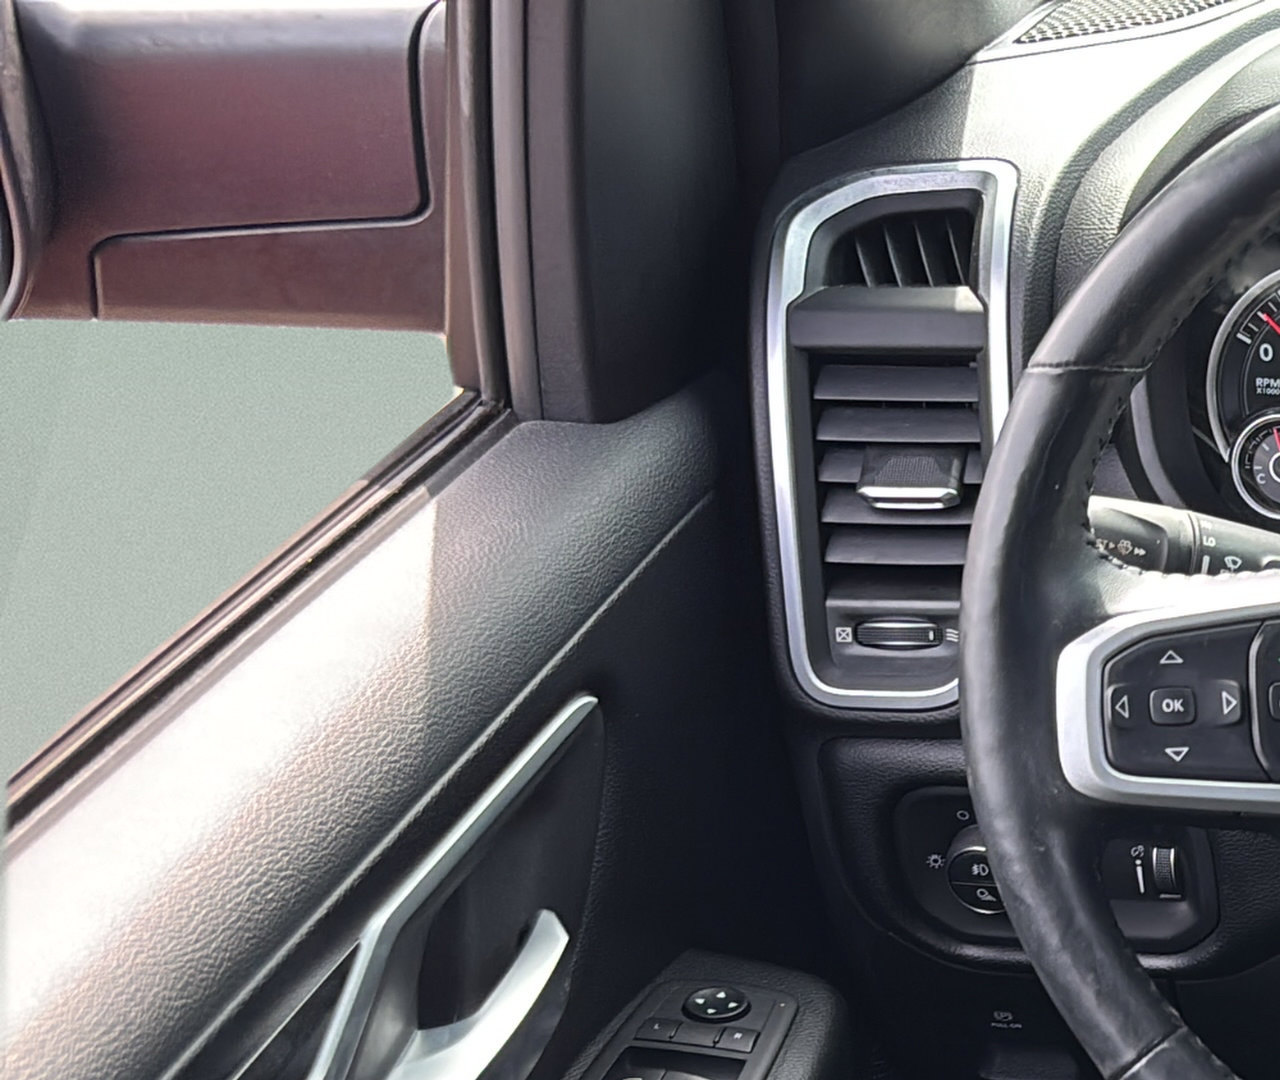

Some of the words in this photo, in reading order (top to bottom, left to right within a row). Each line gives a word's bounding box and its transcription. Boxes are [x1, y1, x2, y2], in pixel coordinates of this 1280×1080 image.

[1259, 344, 1273, 361] 0
[1256, 377, 1280, 387] RPM
[1256, 473, 1266, 484] C
[1162, 698, 1184, 712] OK
